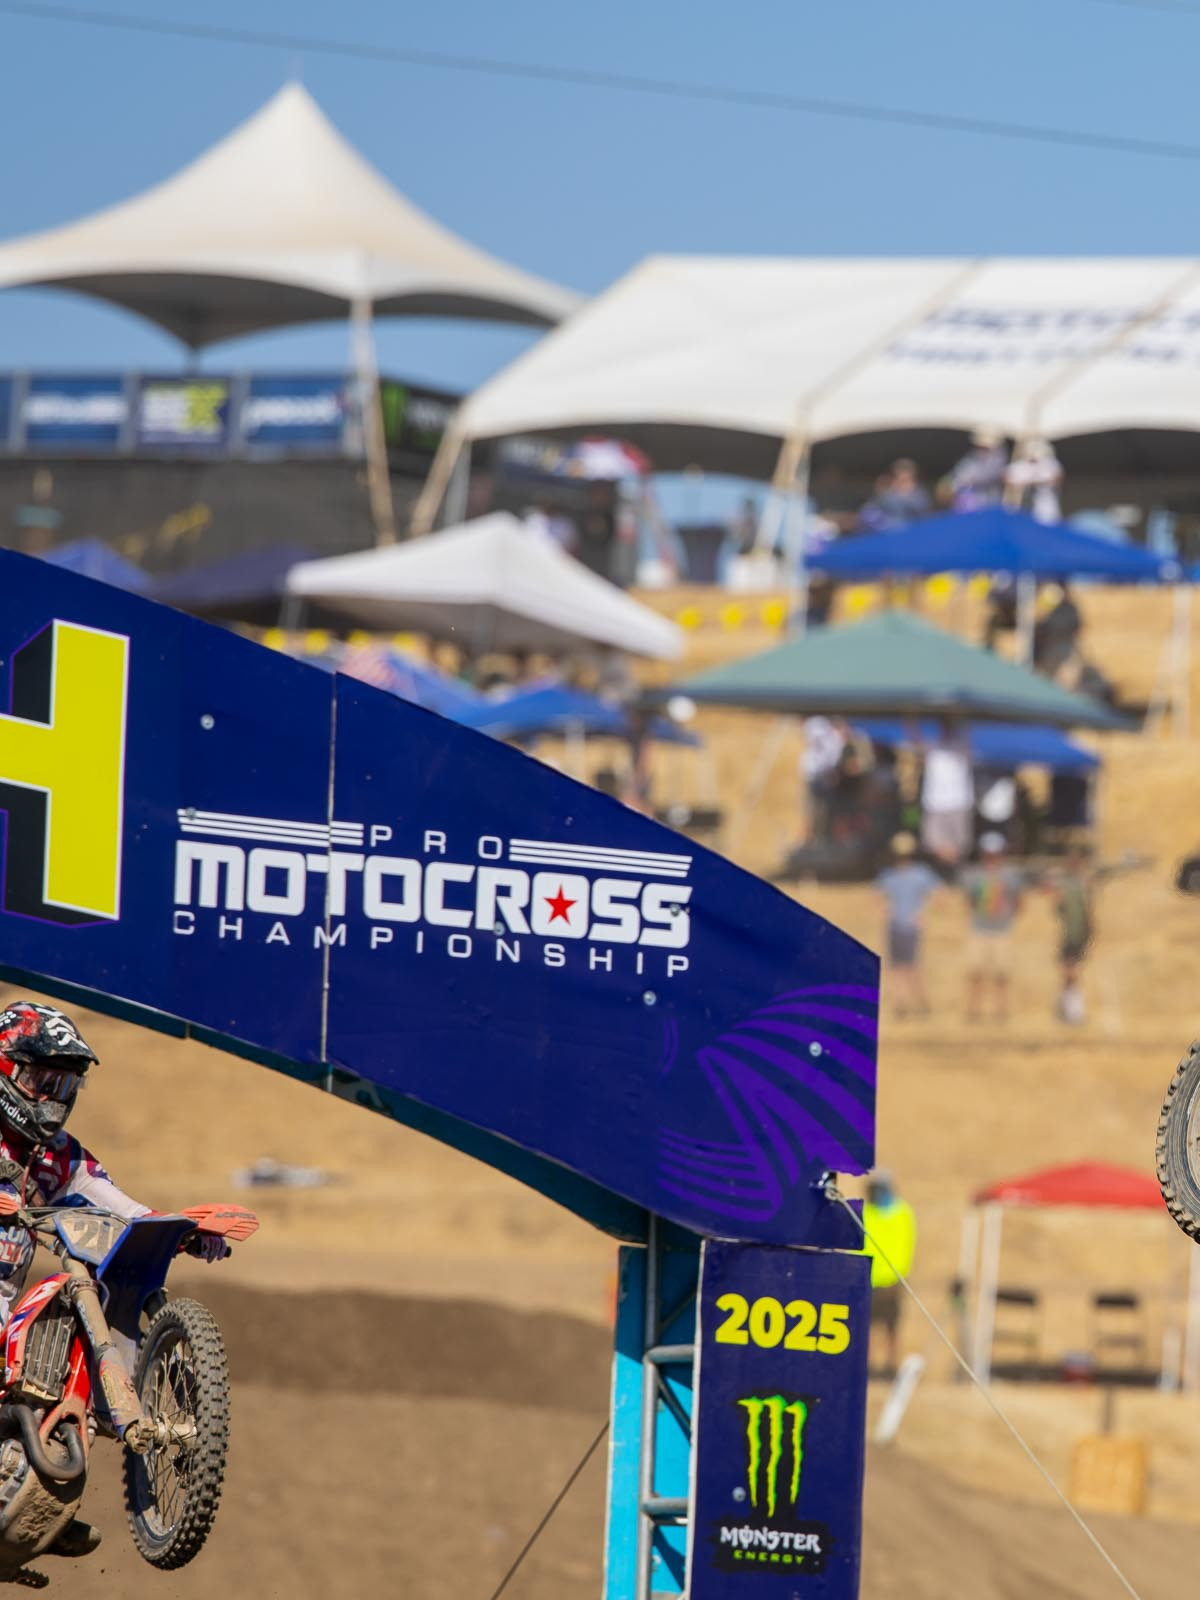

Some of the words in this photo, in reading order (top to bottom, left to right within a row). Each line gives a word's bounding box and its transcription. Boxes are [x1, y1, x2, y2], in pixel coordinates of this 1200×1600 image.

[370, 824, 502, 860] PRO
[173, 840, 693, 949] MOTOCROSS
[172, 910, 690, 978] CHAMPIONSHIP
[715, 1293, 851, 1355] 2025
[720, 1525, 821, 1553] MONSTER
[734, 1551, 805, 1565] ENERGY
